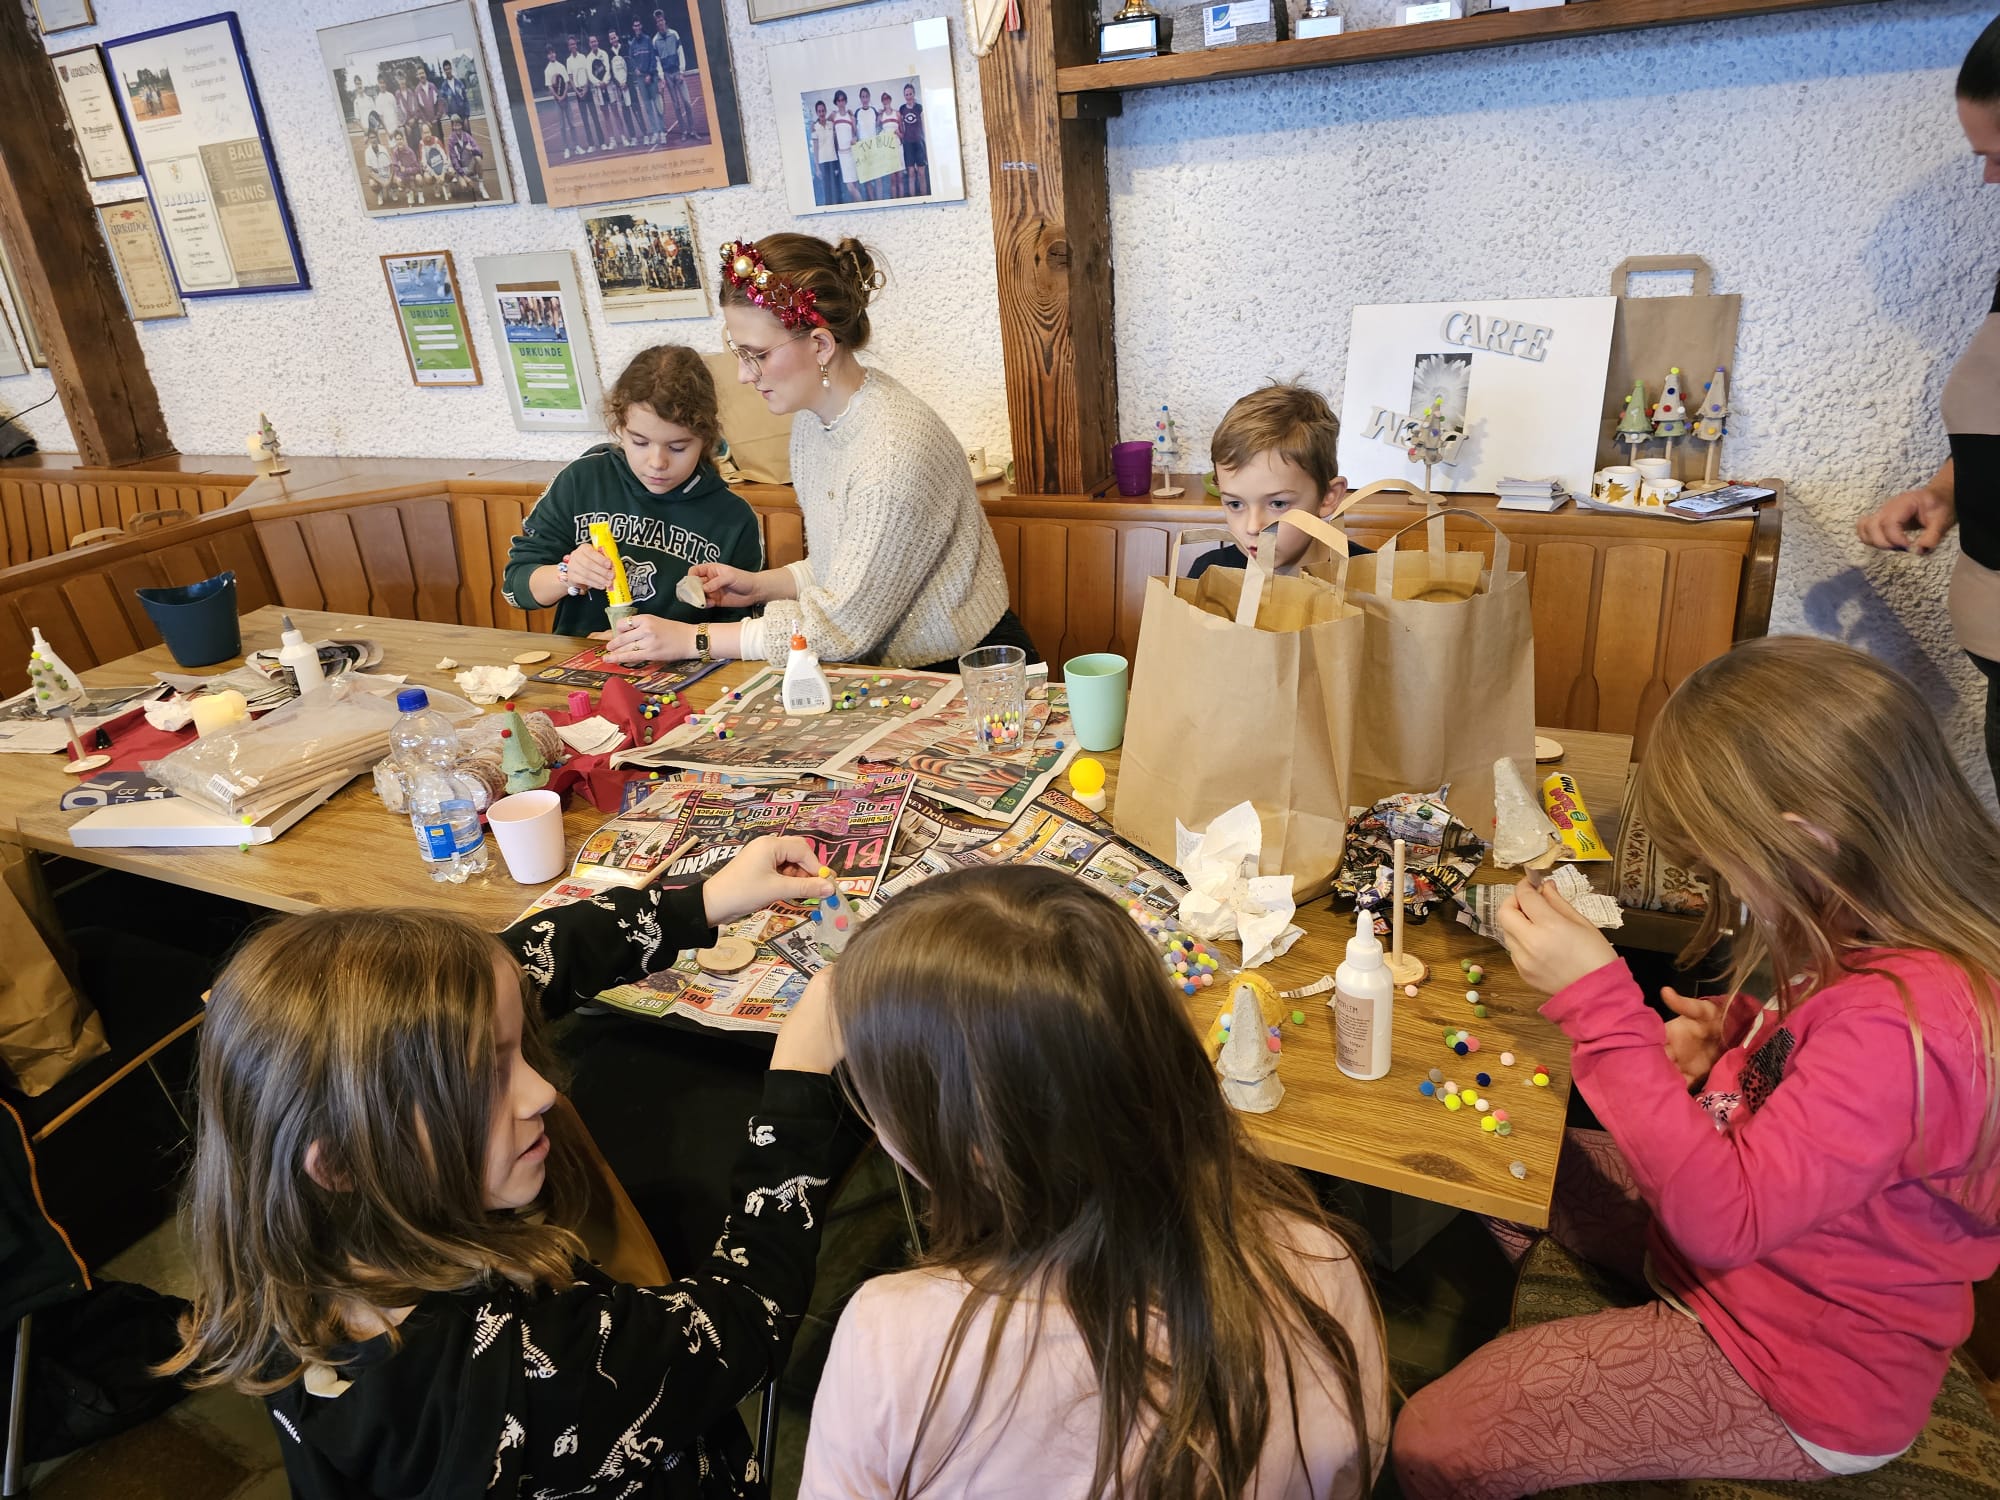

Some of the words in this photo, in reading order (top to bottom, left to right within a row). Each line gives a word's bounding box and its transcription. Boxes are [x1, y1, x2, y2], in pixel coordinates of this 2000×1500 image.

[221, 184, 267, 203] TENNIS
[410, 308, 449, 319] URKUNDE
[1440, 310, 1554, 363] CARPE
[519, 347, 563, 357] URKUNDE
[574, 511, 721, 566] HGWARTS
[1560, 776, 1576, 794] UHU
[922, 806, 962, 830] Deluxe
[667, 845, 744, 876] EEKEND
[806, 838, 884, 869] BLA
[836, 879, 872, 892] NO
